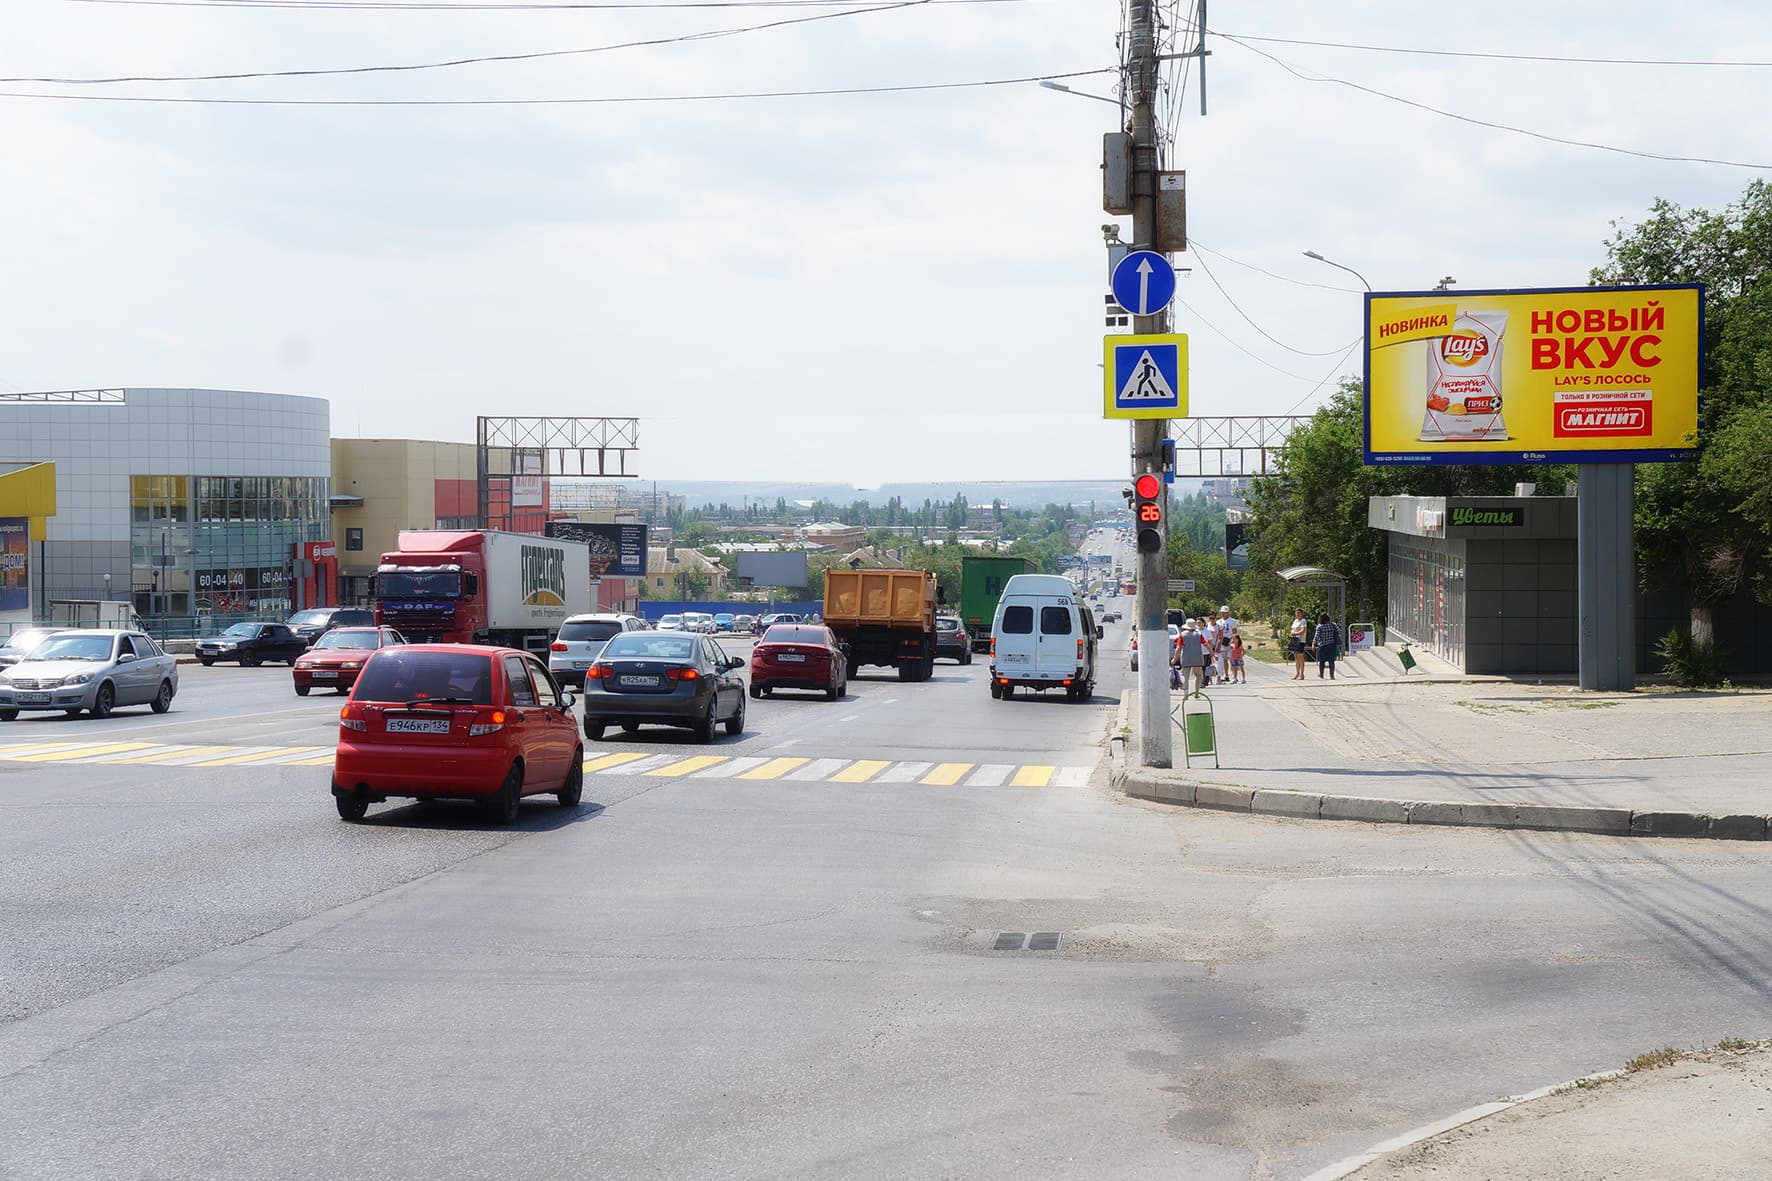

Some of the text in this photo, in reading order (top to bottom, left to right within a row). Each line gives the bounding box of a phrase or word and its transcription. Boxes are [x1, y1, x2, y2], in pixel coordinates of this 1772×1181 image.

[1379, 314, 1448, 338] НОВИНКА
[1530, 300, 1665, 334] НОВЫЙ
[1444, 335, 1485, 361] Lay's
[1531, 334, 1663, 370] ВКУС
[1594, 374, 1652, 385] ЛОСОСЬ
[1561, 393, 1585, 401] ТОЛЬКО
[1591, 391, 1629, 400] РОЗНИЧНОЙ
[1629, 391, 1646, 399] СЕТИ
[1567, 412, 1639, 426] МАГНИТ
[1141, 505, 1160, 521] 26
[1453, 507, 1514, 526] Цветы
[4, 553, 24, 571] ДОМ!
[389, 720, 447, 731] Е946КР 134
